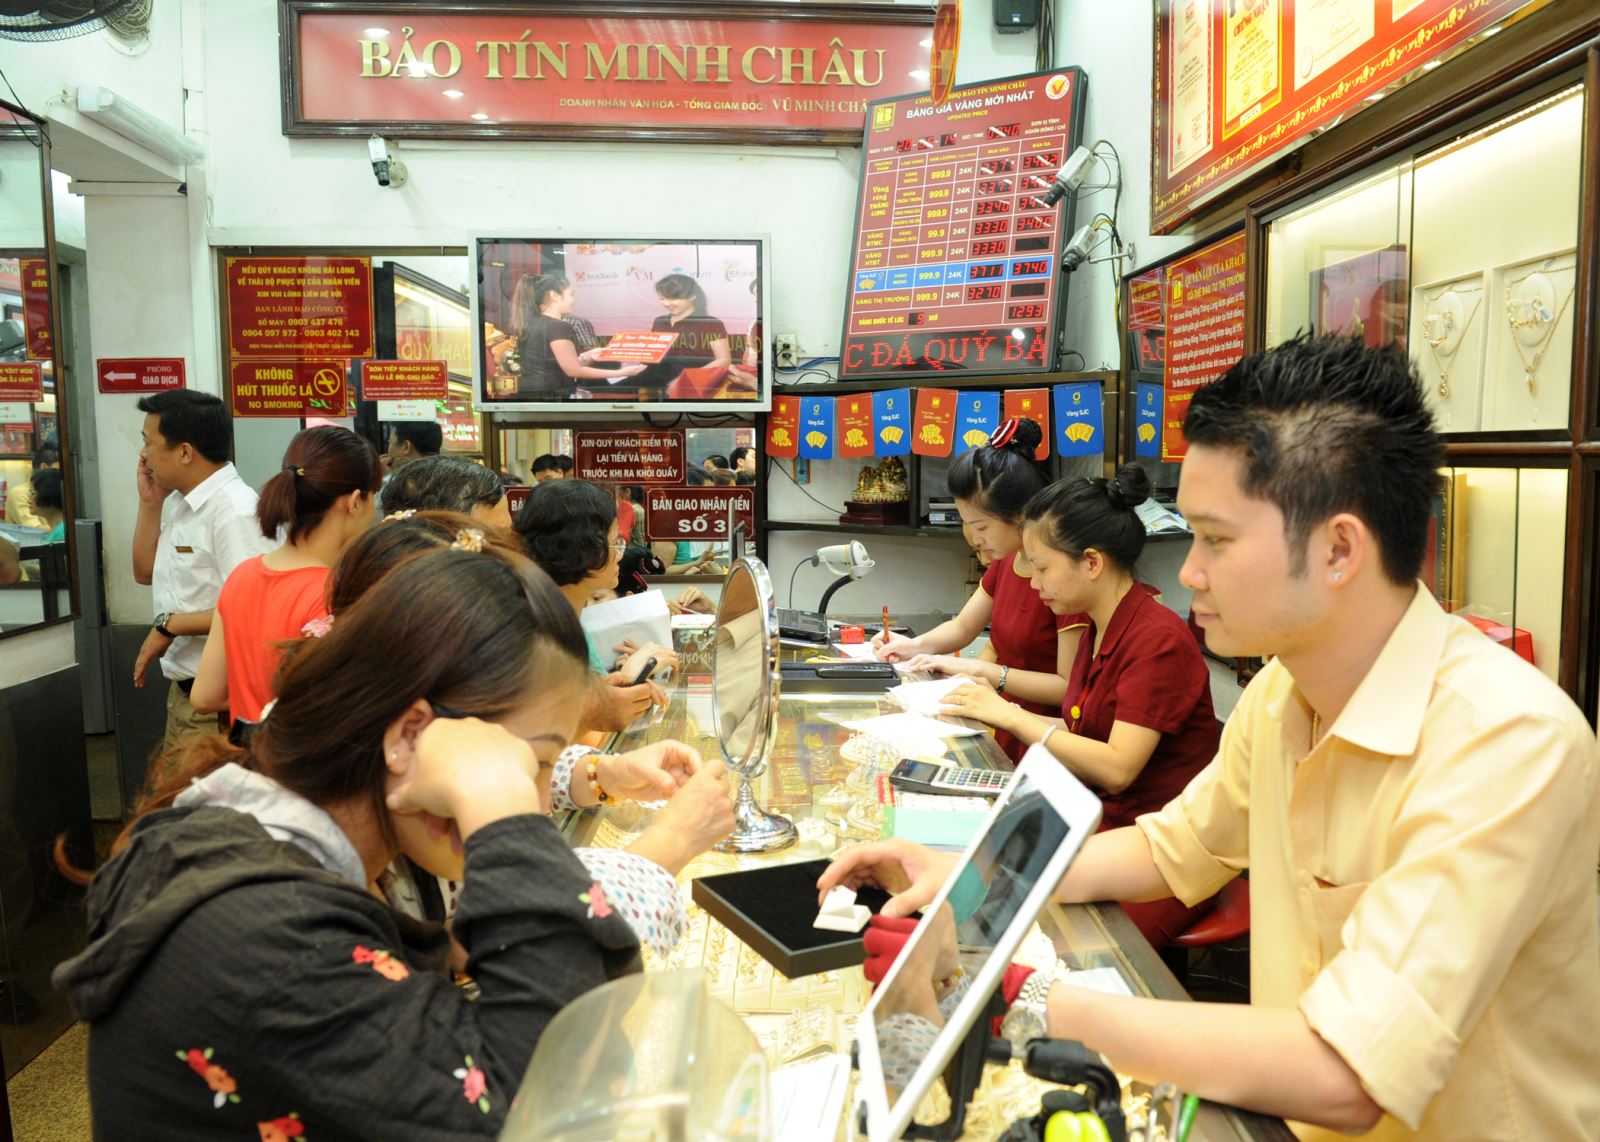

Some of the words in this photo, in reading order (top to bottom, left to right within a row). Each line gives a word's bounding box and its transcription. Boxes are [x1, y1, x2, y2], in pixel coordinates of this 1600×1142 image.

[358, 26, 462, 78] BẢO
[476, 29, 569, 79] TÍN
[584, 42, 732, 83] MINH
[742, 37, 887, 87] CHÂU
[560, 98, 595, 107] DOANH
[795, 99, 835, 112] MINH
[838, 98, 868, 113] CHÂ
[907, 106, 933, 119] BẢNG
[955, 97, 982, 111] VÀNG
[985, 93, 1004, 107] MỚI
[1007, 89, 1034, 102] NHẤT
[973, 109, 988, 117] PRICE
[931, 170, 951, 179] 999.9
[959, 167, 972, 175] 24K
[929, 189, 949, 199] 999.9
[957, 187, 970, 195] 24K
[955, 207, 968, 215] 24K
[977, 200, 1010, 215] 3340
[871, 209, 886, 217] LONG
[927, 209, 947, 219] 999.9
[953, 227, 967, 235] 24K
[976, 219, 1008, 235] 3330
[928, 229, 944, 238] 99.9
[921, 248, 943, 258] 999.9
[950, 247, 964, 255] 24K
[973, 241, 1006, 255] 3330
[970, 264, 1004, 279] 3711
[1014, 261, 1048, 275] 3740
[919, 271, 940, 280] 999.9
[948, 271, 962, 279] 24K
[271, 290, 282, 298] VUI
[916, 292, 938, 302] 999.9
[946, 291, 960, 299] 24K
[968, 286, 1001, 300] 3270
[1010, 304, 1043, 318] 1293
[288, 318, 308, 326] 0903
[311, 318, 325, 326] 437
[918, 312, 924, 325] 9
[242, 329, 262, 337] 0904
[265, 329, 280, 337] 097
[282, 329, 297, 337] 972
[304, 329, 325, 337] 0903
[327, 329, 342, 337] 402
[346, 329, 359, 337] 143
[870, 334, 916, 367] ĐÁ
[924, 329, 996, 370] QUÝ
[147, 364, 172, 373] PHÒNG
[255, 366, 293, 380] KHÔNG
[143, 375, 160, 385] GIAO
[161, 375, 178, 386] DỊCH
[237, 382, 258, 396] HÚT
[261, 381, 296, 396] THUỐC
[300, 382, 313, 396] LÁ
[249, 401, 261, 409] NO
[264, 401, 303, 409] SMOKING
[582, 439, 594, 447] XIN
[596, 437, 612, 448] QUÝ
[615, 437, 640, 447] KHÁCH
[641, 434, 661, 448] KIỂM
[663, 439, 678, 447] TRA
[597, 454, 608, 465] LẠI
[629, 452, 639, 462] VÀ
[641, 452, 663, 463] HÀNG
[582, 468, 608, 478] TRƯỚC
[610, 469, 622, 478] KHI
[624, 469, 634, 478] RA
[637, 465, 654, 478] KHỎI
[675, 499, 698, 511] GIAO
[701, 496, 726, 514] NHẬN
[730, 494, 749, 511] IỀN
[679, 513, 708, 533] SỐ
[714, 520, 726, 533] 3
